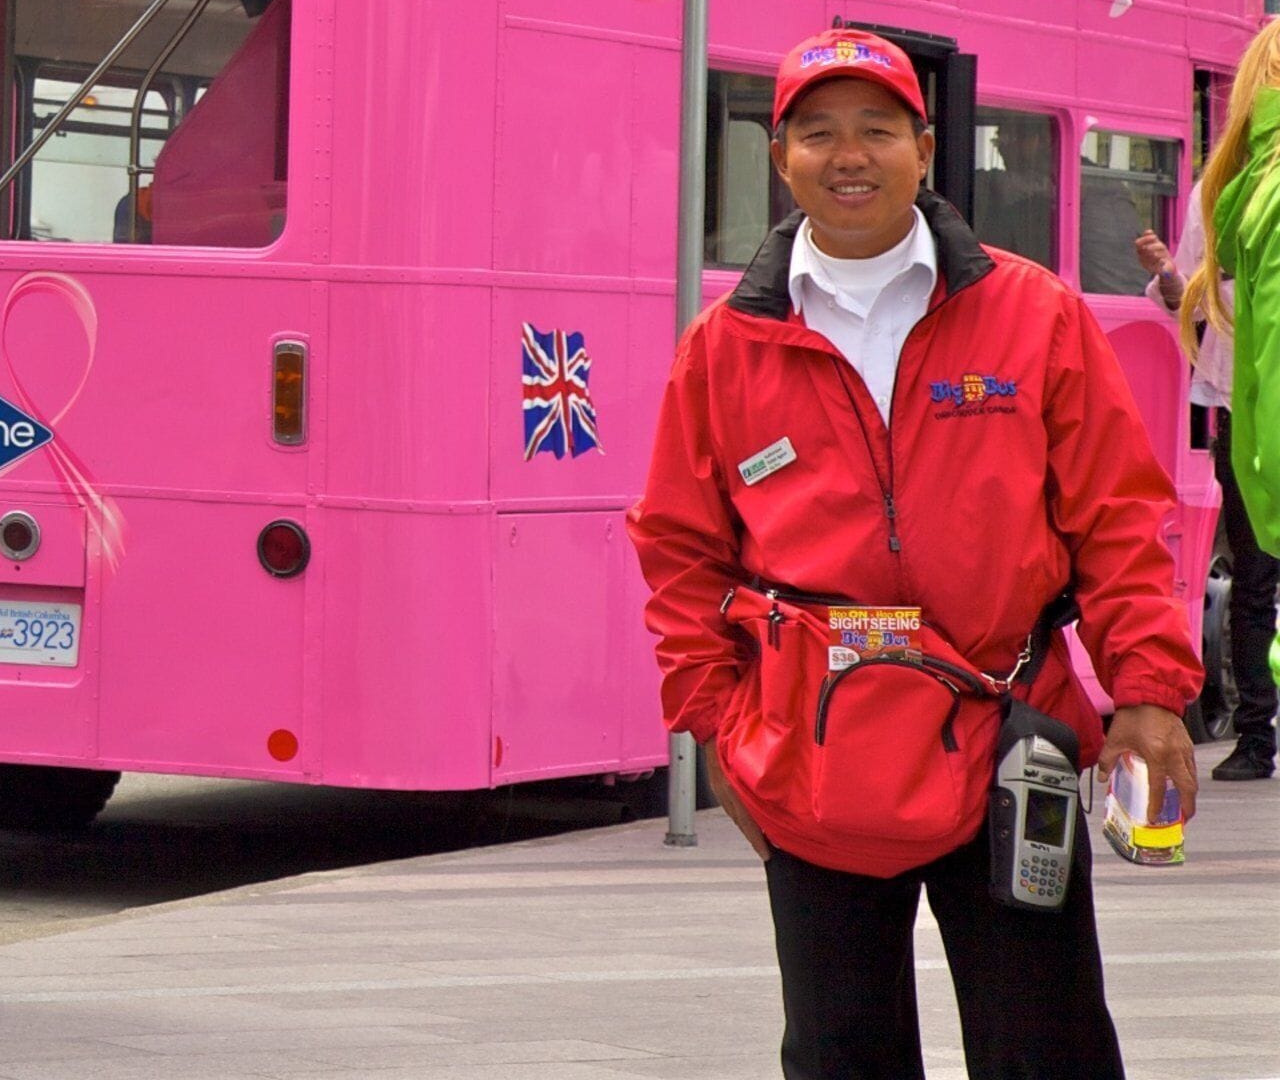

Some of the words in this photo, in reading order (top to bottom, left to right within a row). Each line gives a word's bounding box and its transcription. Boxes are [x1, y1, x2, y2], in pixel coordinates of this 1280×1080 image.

[10, 608, 33, 618] British
[35, 610, 70, 620] Columbia
[848, 610, 868, 618] ON
[829, 617, 920, 630] SIGHTSEEING
[13, 619, 75, 649] 3923
[841, 631, 867, 650] Big
[882, 631, 910, 646] Bus
